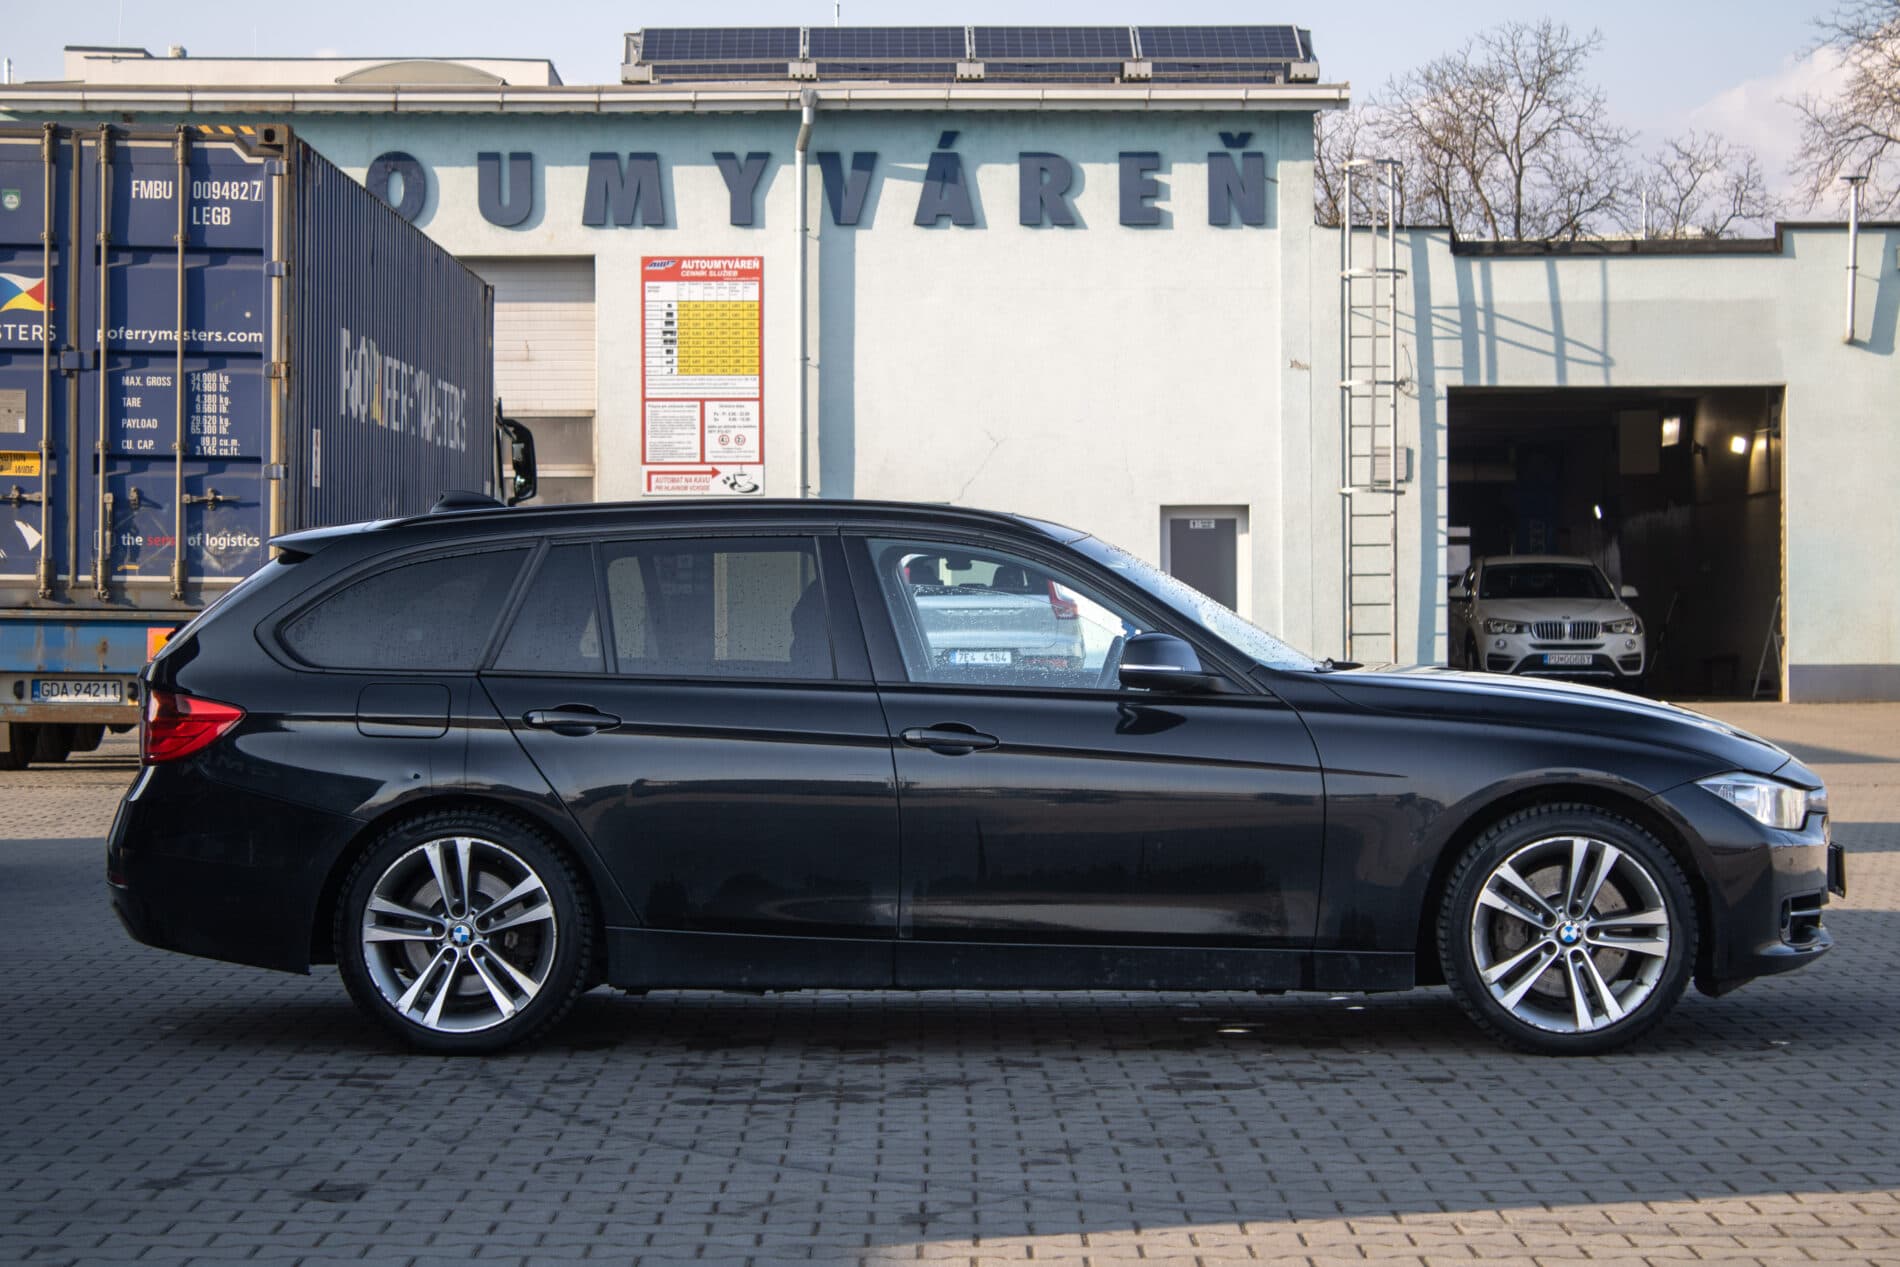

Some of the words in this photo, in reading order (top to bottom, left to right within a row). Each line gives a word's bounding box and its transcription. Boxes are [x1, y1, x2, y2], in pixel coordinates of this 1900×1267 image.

[131, 180, 173, 199] FMBU
[192, 206, 231, 225] LEGB
[681, 257, 759, 269] AUTOUMYVÁREŇ
[146, 376, 172, 387] GROSS
[122, 397, 142, 408] TARE
[121, 418, 158, 430] PAYLOAD
[121, 532, 143, 546] the
[147, 535, 176, 547] sens
[187, 532, 202, 546] of
[205, 533, 260, 550] logistics
[41, 682, 69, 697] GDA
[73, 682, 118, 698] 94211
